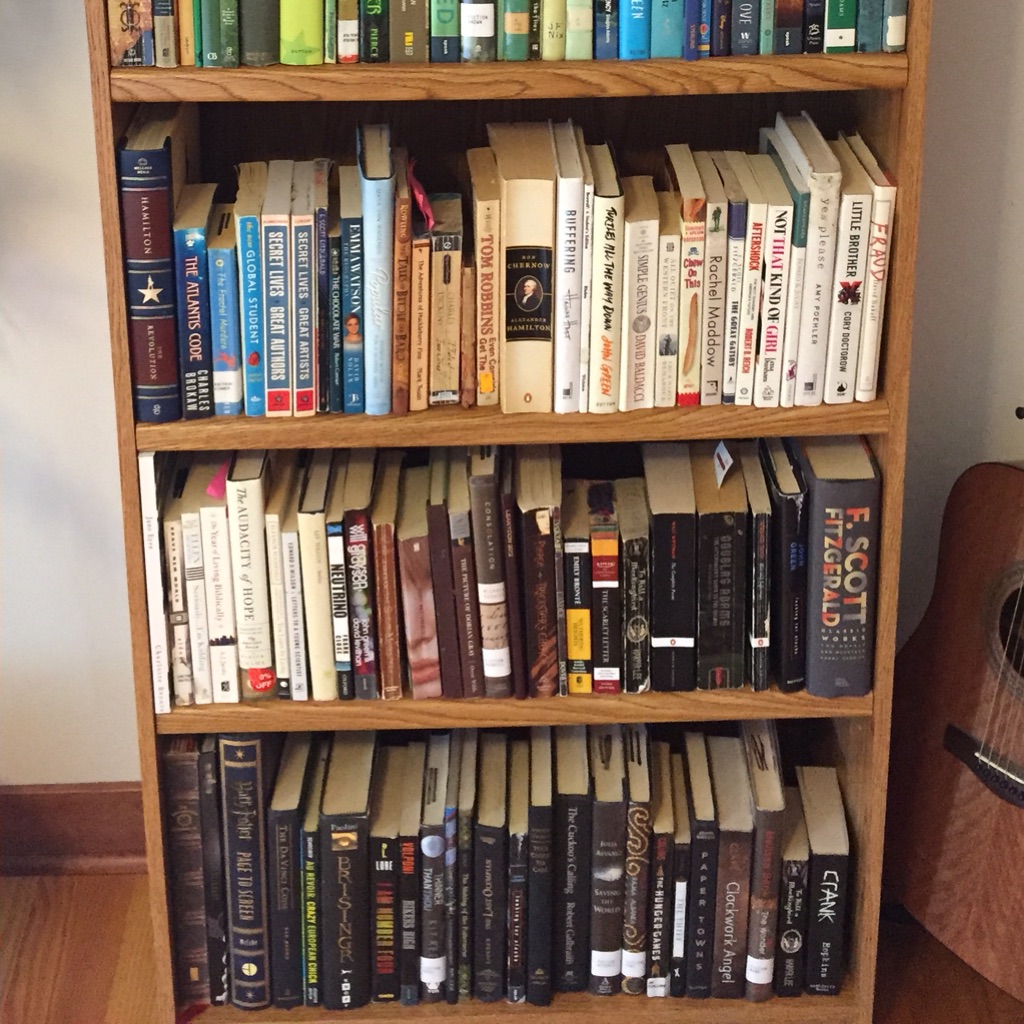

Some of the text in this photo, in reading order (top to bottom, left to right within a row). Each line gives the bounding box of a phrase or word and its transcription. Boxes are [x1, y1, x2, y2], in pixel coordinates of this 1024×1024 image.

[740, 4, 752, 24] OVE
[141, 197, 152, 254] HAMILTON
[564, 210, 576, 273] BUFFERING
[749, 222, 762, 271] AFTERSHOCK
[771, 237, 785, 269] THAT
[774, 210, 788, 235] NOT
[846, 202, 863, 277] LITTLE BROTHER
[269, 231, 285, 381] SECRET LIVES GREAT AUTHORS
[298, 231, 309, 380] SECRET LIVES GREAT ARTISTS
[481, 235, 494, 335] TOM ROBBINS
[706, 256, 722, 367] Rachel Maddow
[768, 307, 780, 322] OF
[769, 273, 782, 305] KIND
[765, 326, 779, 353] GIRL
[197, 370, 210, 411] CHARLES
[236, 488, 254, 621] The AUDACITY of HOPE
[484, 502, 495, 569] CONSOLATION
[843, 507, 870, 624] F. SCOTT
[331, 564, 347, 618] NEUTRINO
[821, 508, 843, 626] FITZGERALD
[565, 807, 577, 894] The Cuckoo's Calling
[237, 852, 254, 920] PAGE TO SCREEN
[654, 891, 664, 929] HUNGER
[565, 902, 575, 964] Robert Galbraith
[652, 931, 662, 960] GAMES
[719, 882, 739, 983] Clockwork Angel
[821, 942, 831, 978] Hopkins
